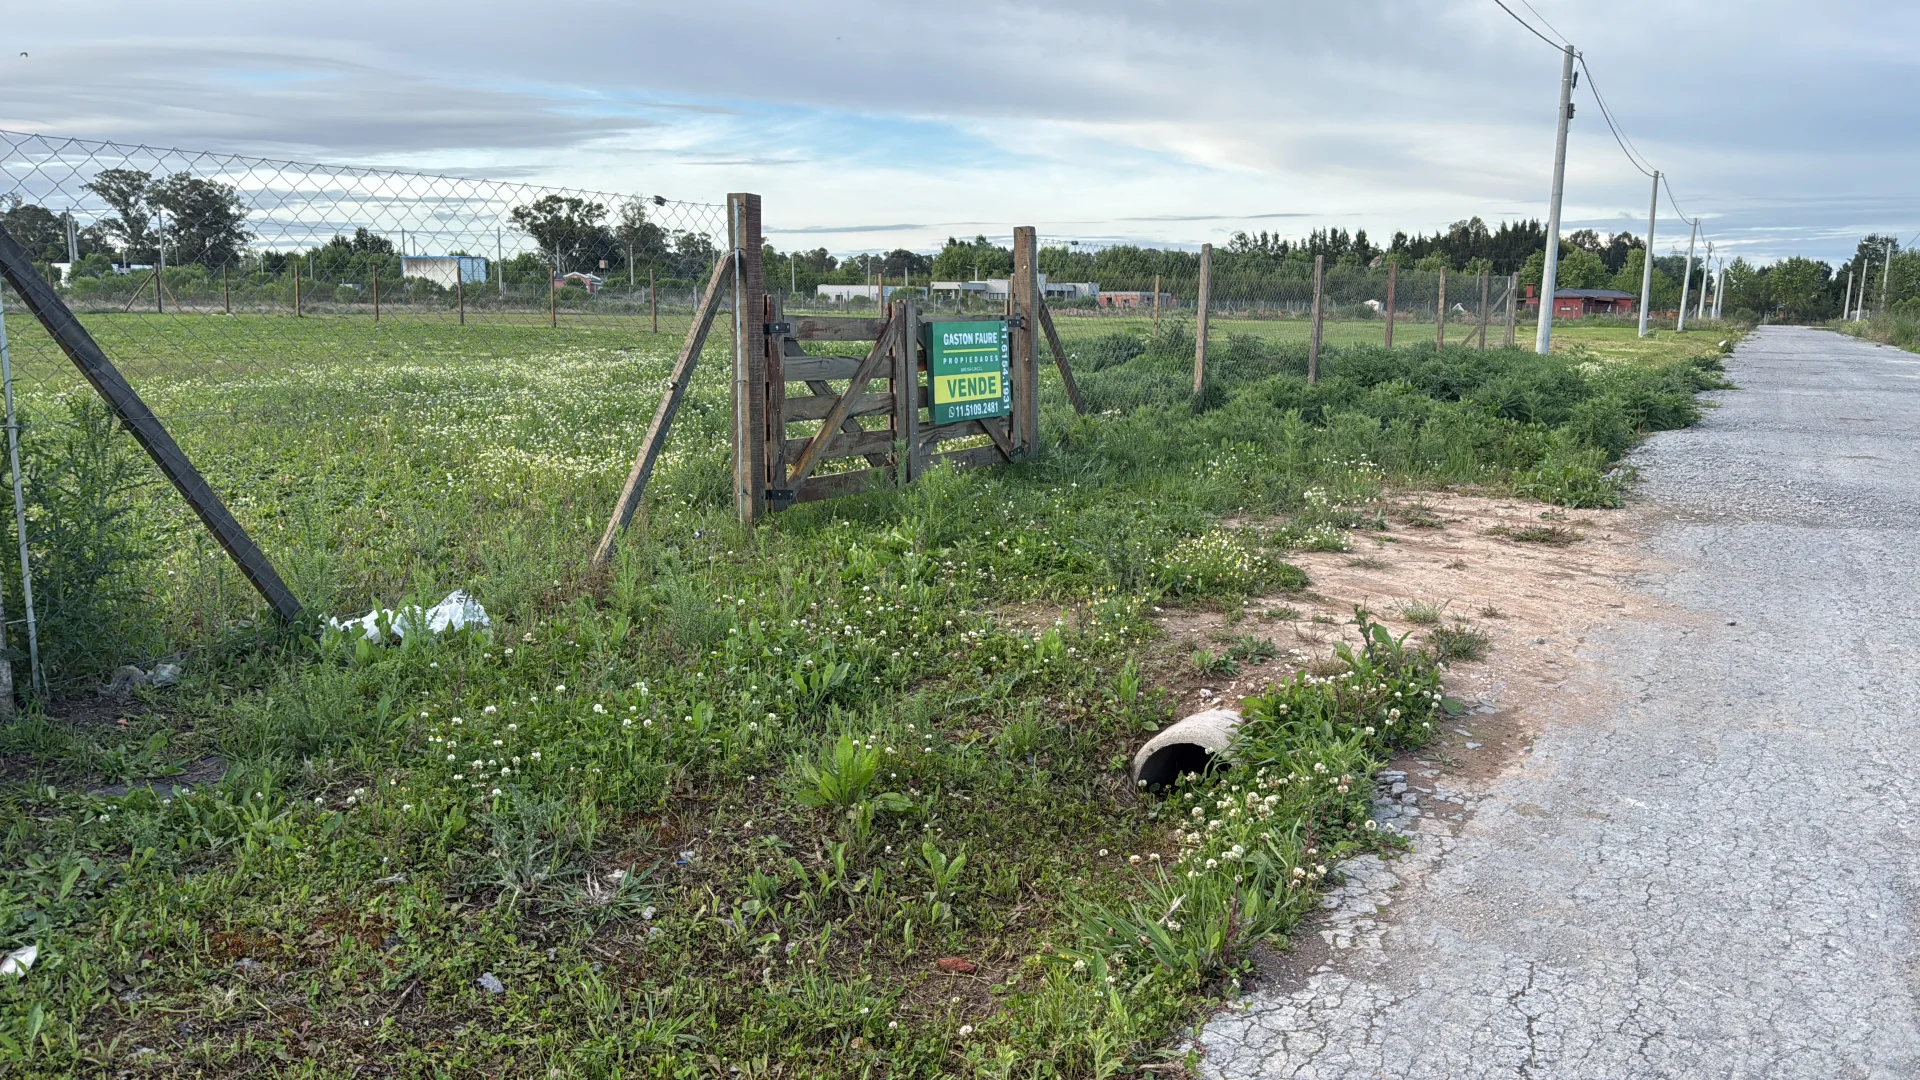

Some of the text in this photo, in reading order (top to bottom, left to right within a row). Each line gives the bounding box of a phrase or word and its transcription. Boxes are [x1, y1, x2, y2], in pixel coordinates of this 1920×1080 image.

[943, 332, 998, 346] GASTON FAURE
[943, 355, 998, 364] PROPIEDADES
[1001, 326, 1010, 409] 11.6154.1931
[946, 376, 997, 398] VENDE
[955, 401, 998, 417] 11.5109.2481
